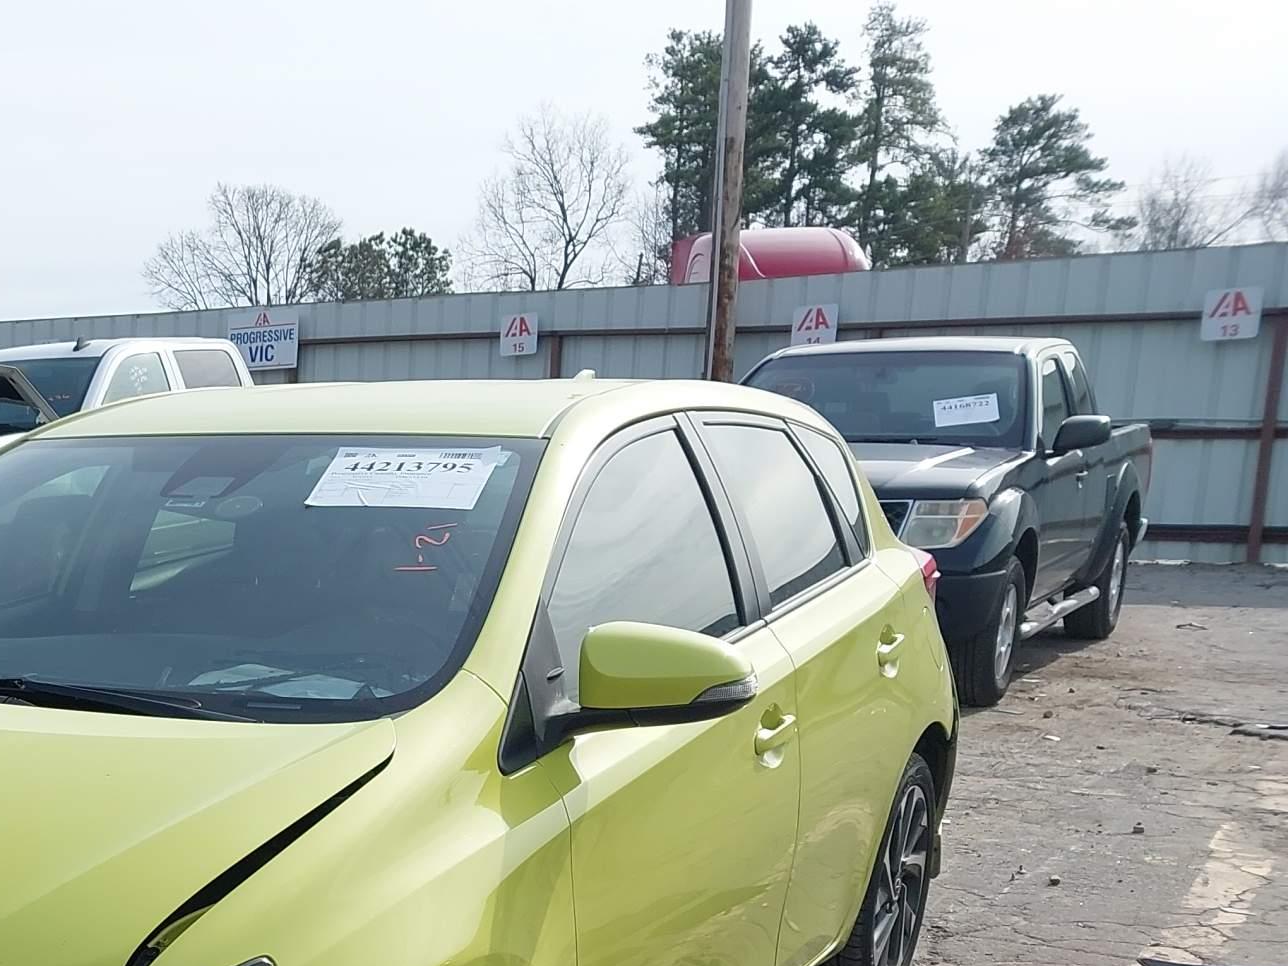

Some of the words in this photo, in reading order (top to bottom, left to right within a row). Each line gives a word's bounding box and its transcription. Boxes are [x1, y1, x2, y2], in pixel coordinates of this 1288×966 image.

[230, 328, 295, 344] PROGRESSIVE
[1220, 324, 1240, 337] 13
[249, 345, 275, 363] VIC
[512, 342, 525, 353] 15
[344, 461, 474, 474] 44213795
